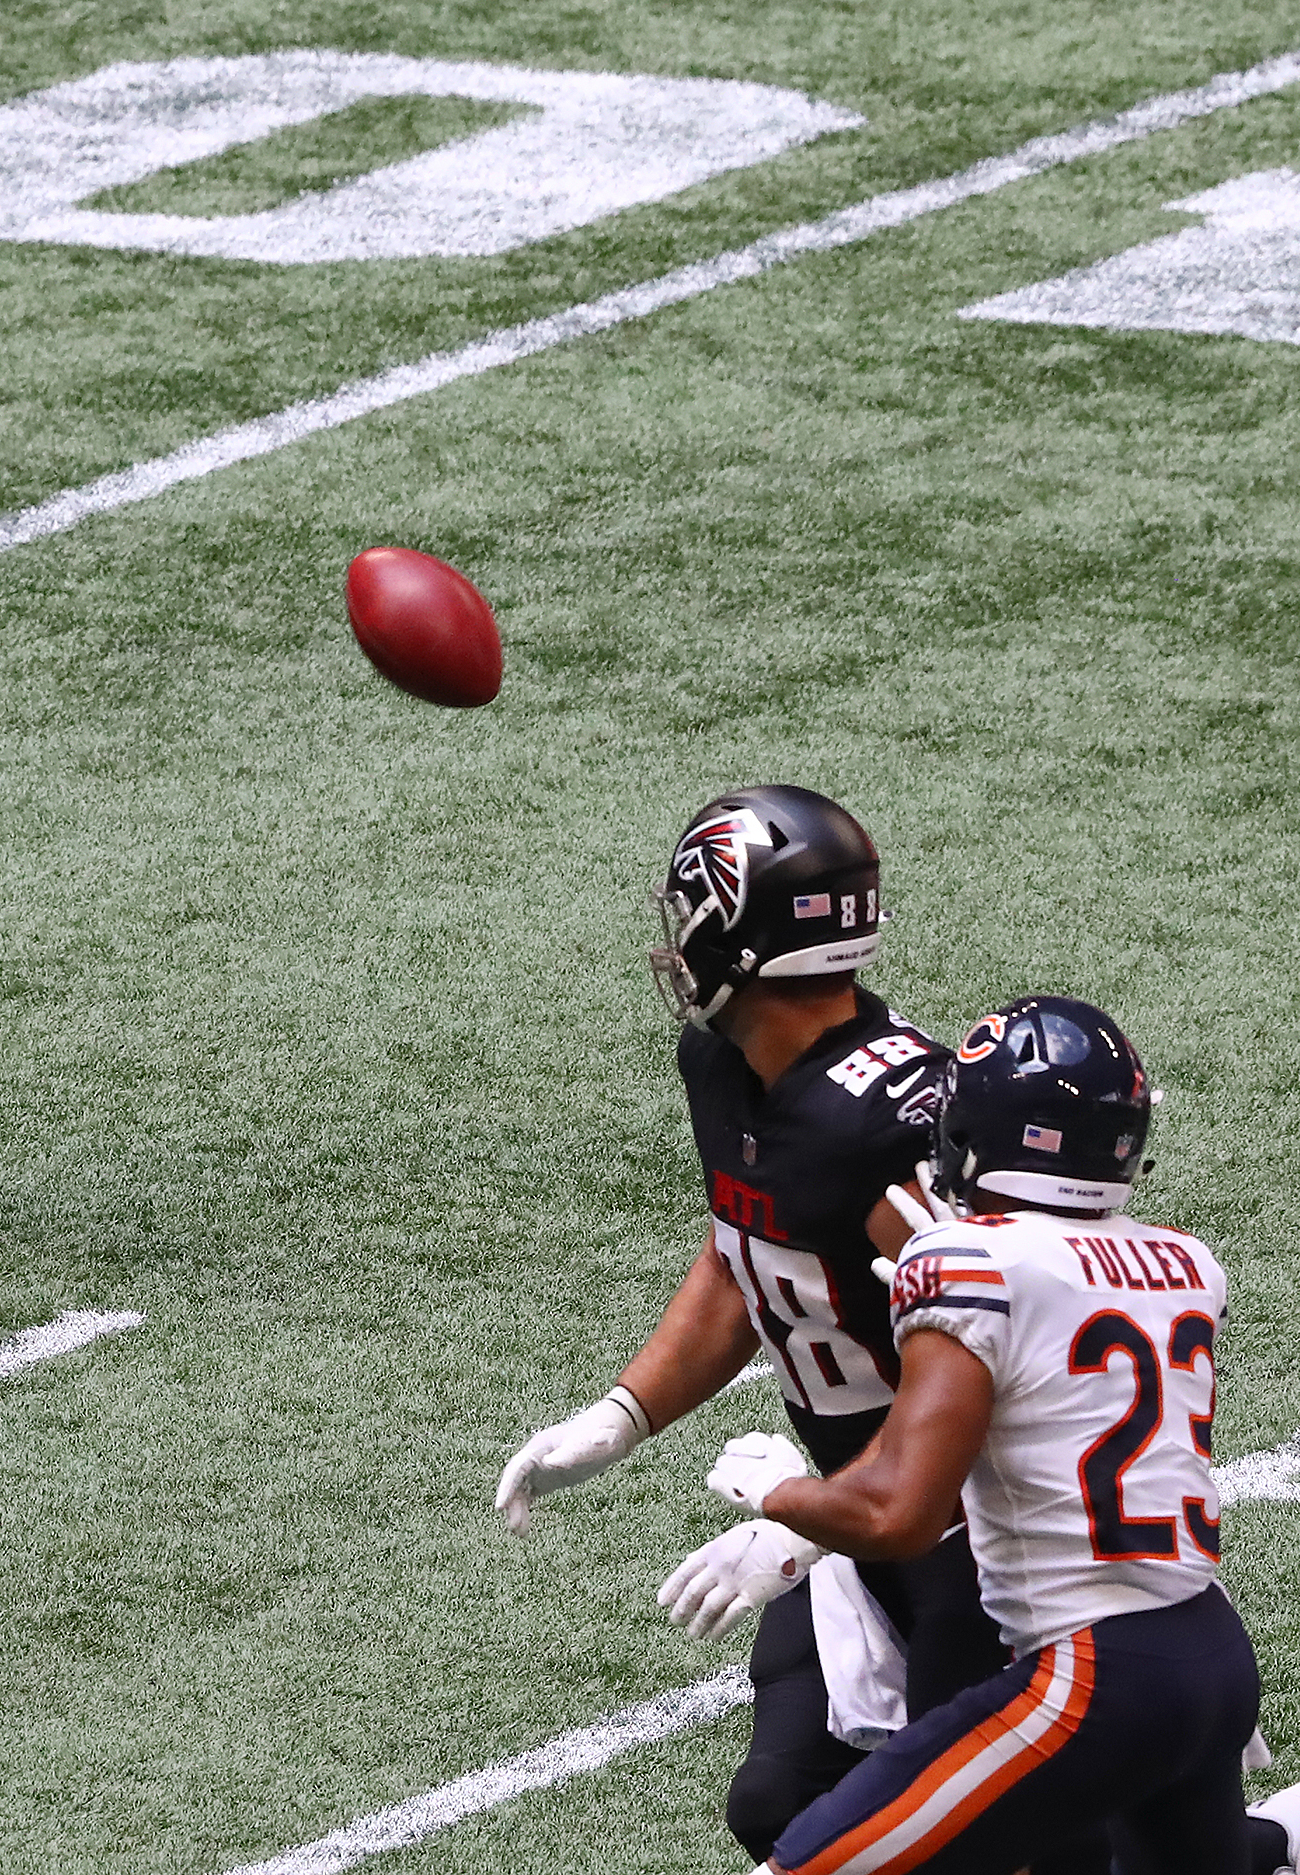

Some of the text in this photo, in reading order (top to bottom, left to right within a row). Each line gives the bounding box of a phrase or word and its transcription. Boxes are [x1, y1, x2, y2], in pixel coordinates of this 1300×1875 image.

[826, 1034, 931, 1098] 88
[956, 1014, 1006, 1064] C
[712, 1169, 789, 1241] ATL
[1062, 1236, 1207, 1291] FULLER
[1068, 1307, 1221, 1564] 23
